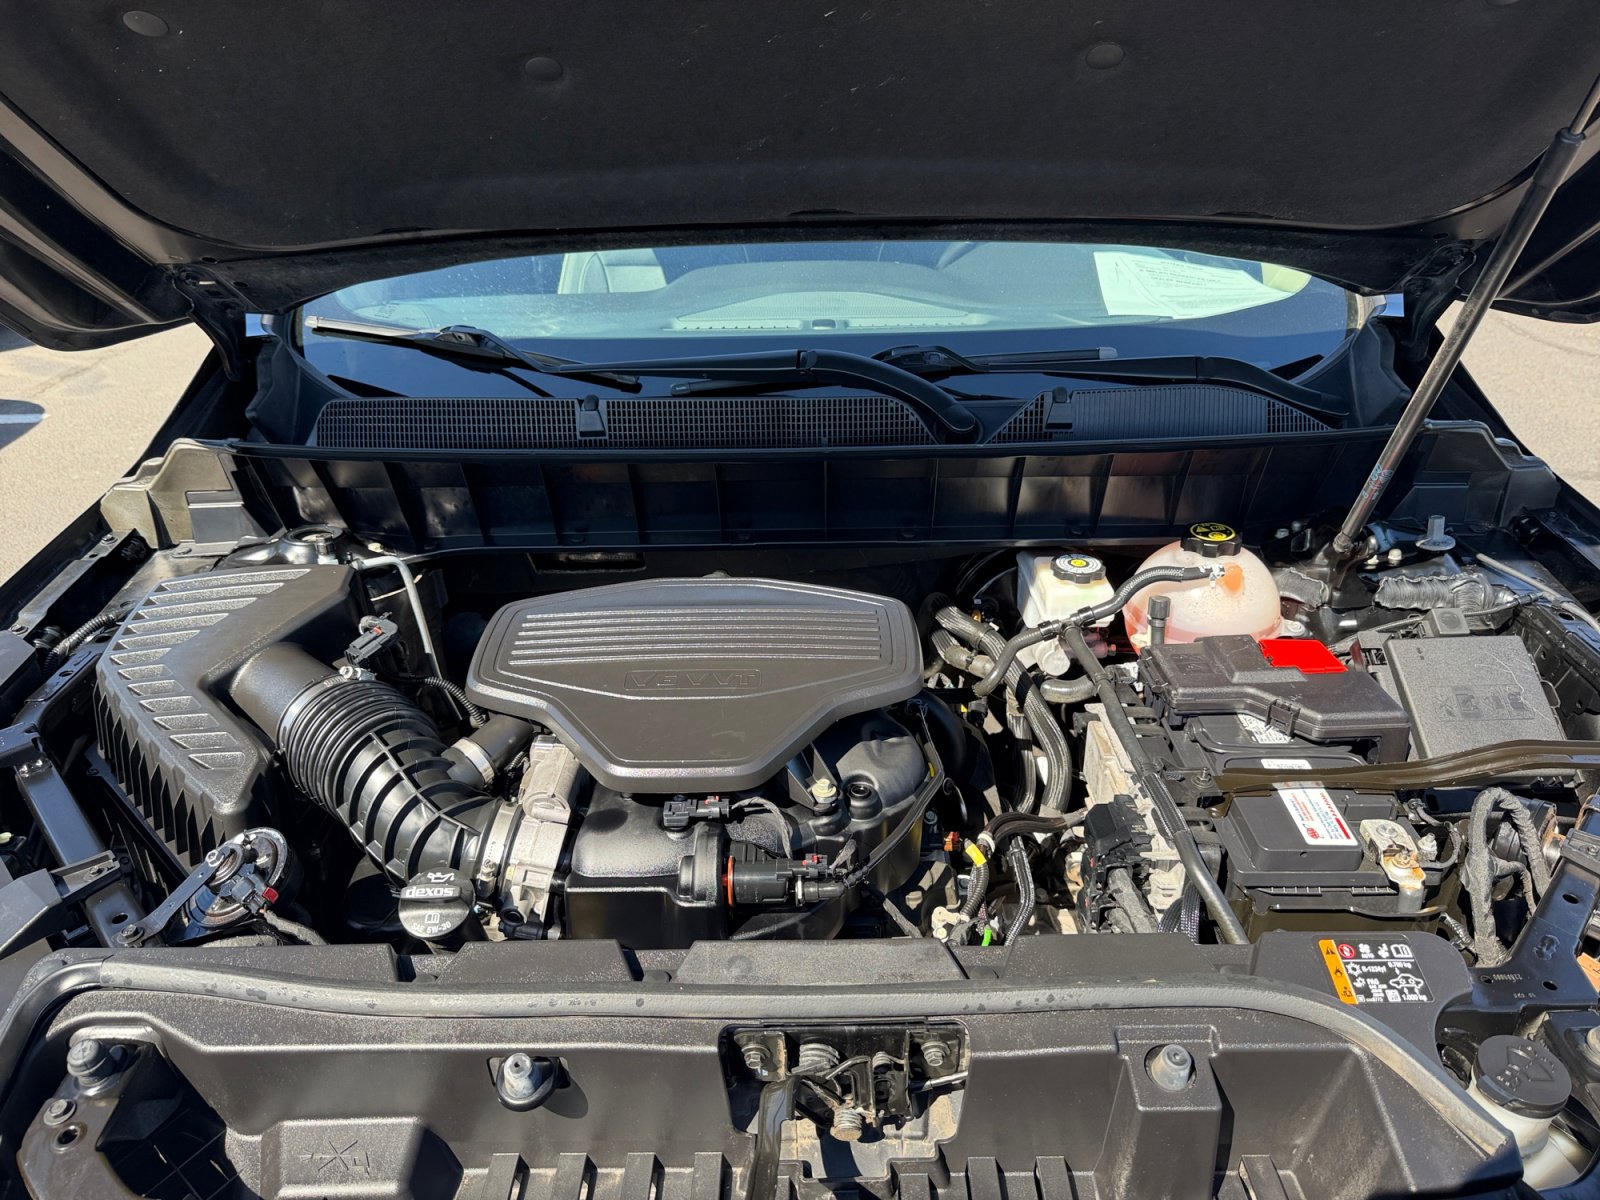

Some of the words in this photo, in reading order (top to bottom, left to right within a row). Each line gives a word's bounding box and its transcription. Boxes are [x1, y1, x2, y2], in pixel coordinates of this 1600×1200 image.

[686, 672, 757, 686] VVT
[405, 886, 455, 898] dexos
[411, 922, 425, 932] SAE
[426, 921, 452, 934] 5W-30
